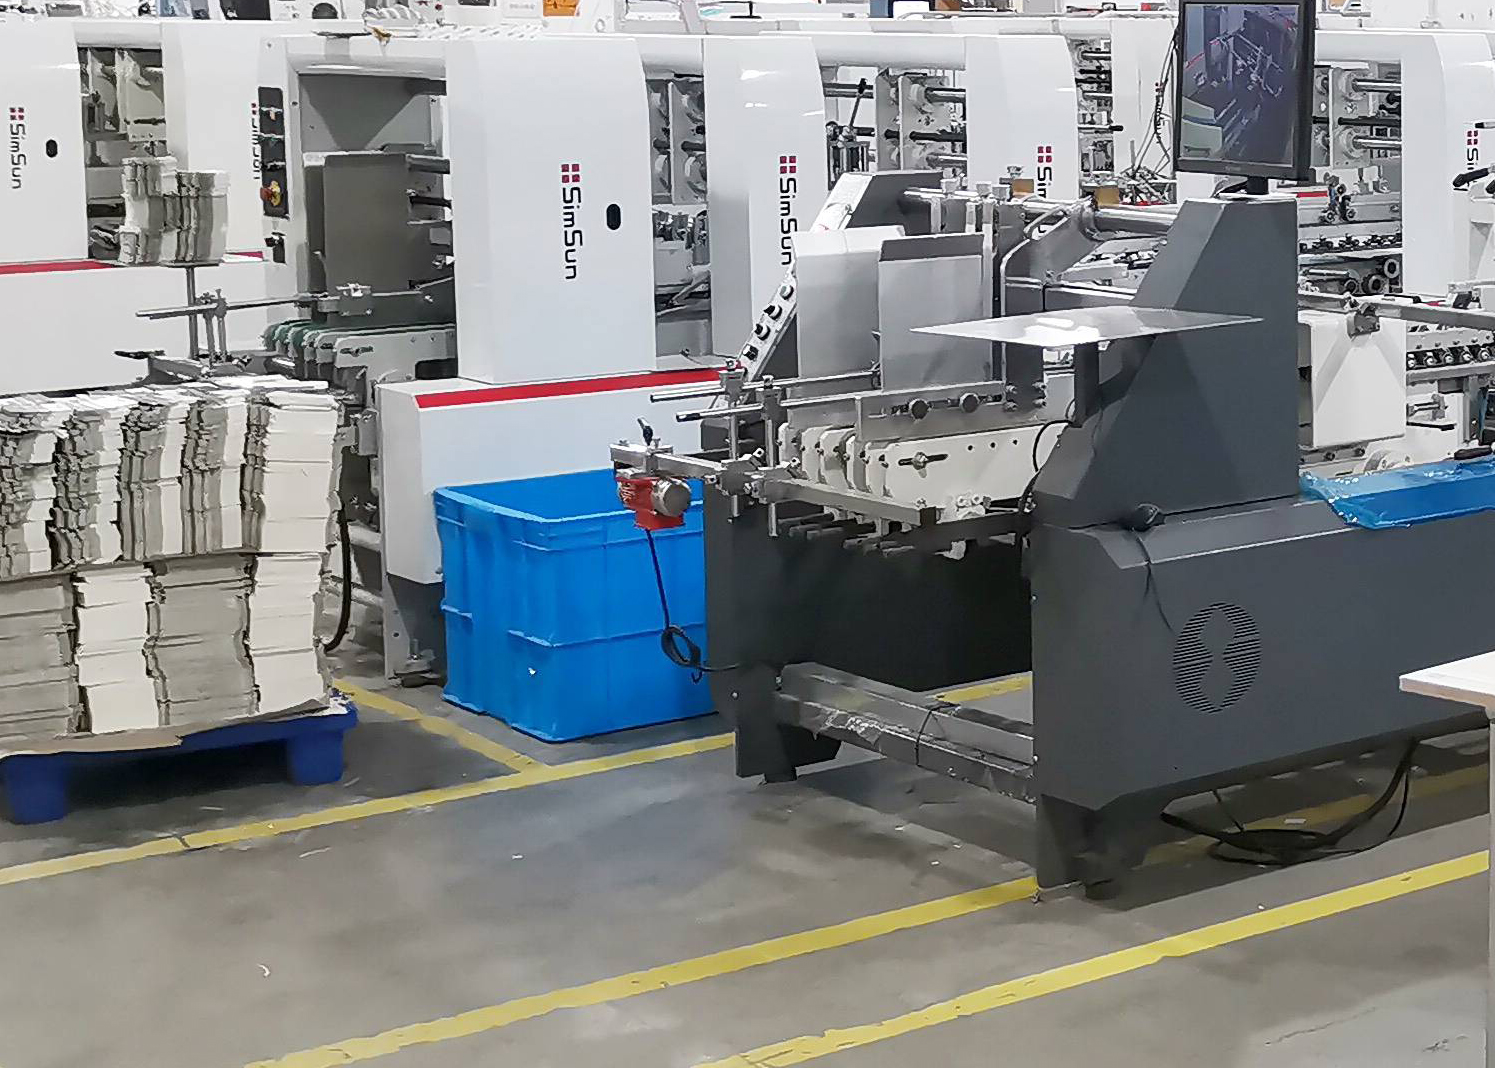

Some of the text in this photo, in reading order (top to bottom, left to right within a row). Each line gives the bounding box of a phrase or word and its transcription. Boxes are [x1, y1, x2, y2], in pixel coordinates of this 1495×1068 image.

[9, 123, 27, 190] SimSun
[562, 187, 583, 280] SimSun
[779, 177, 798, 266] SimSun
